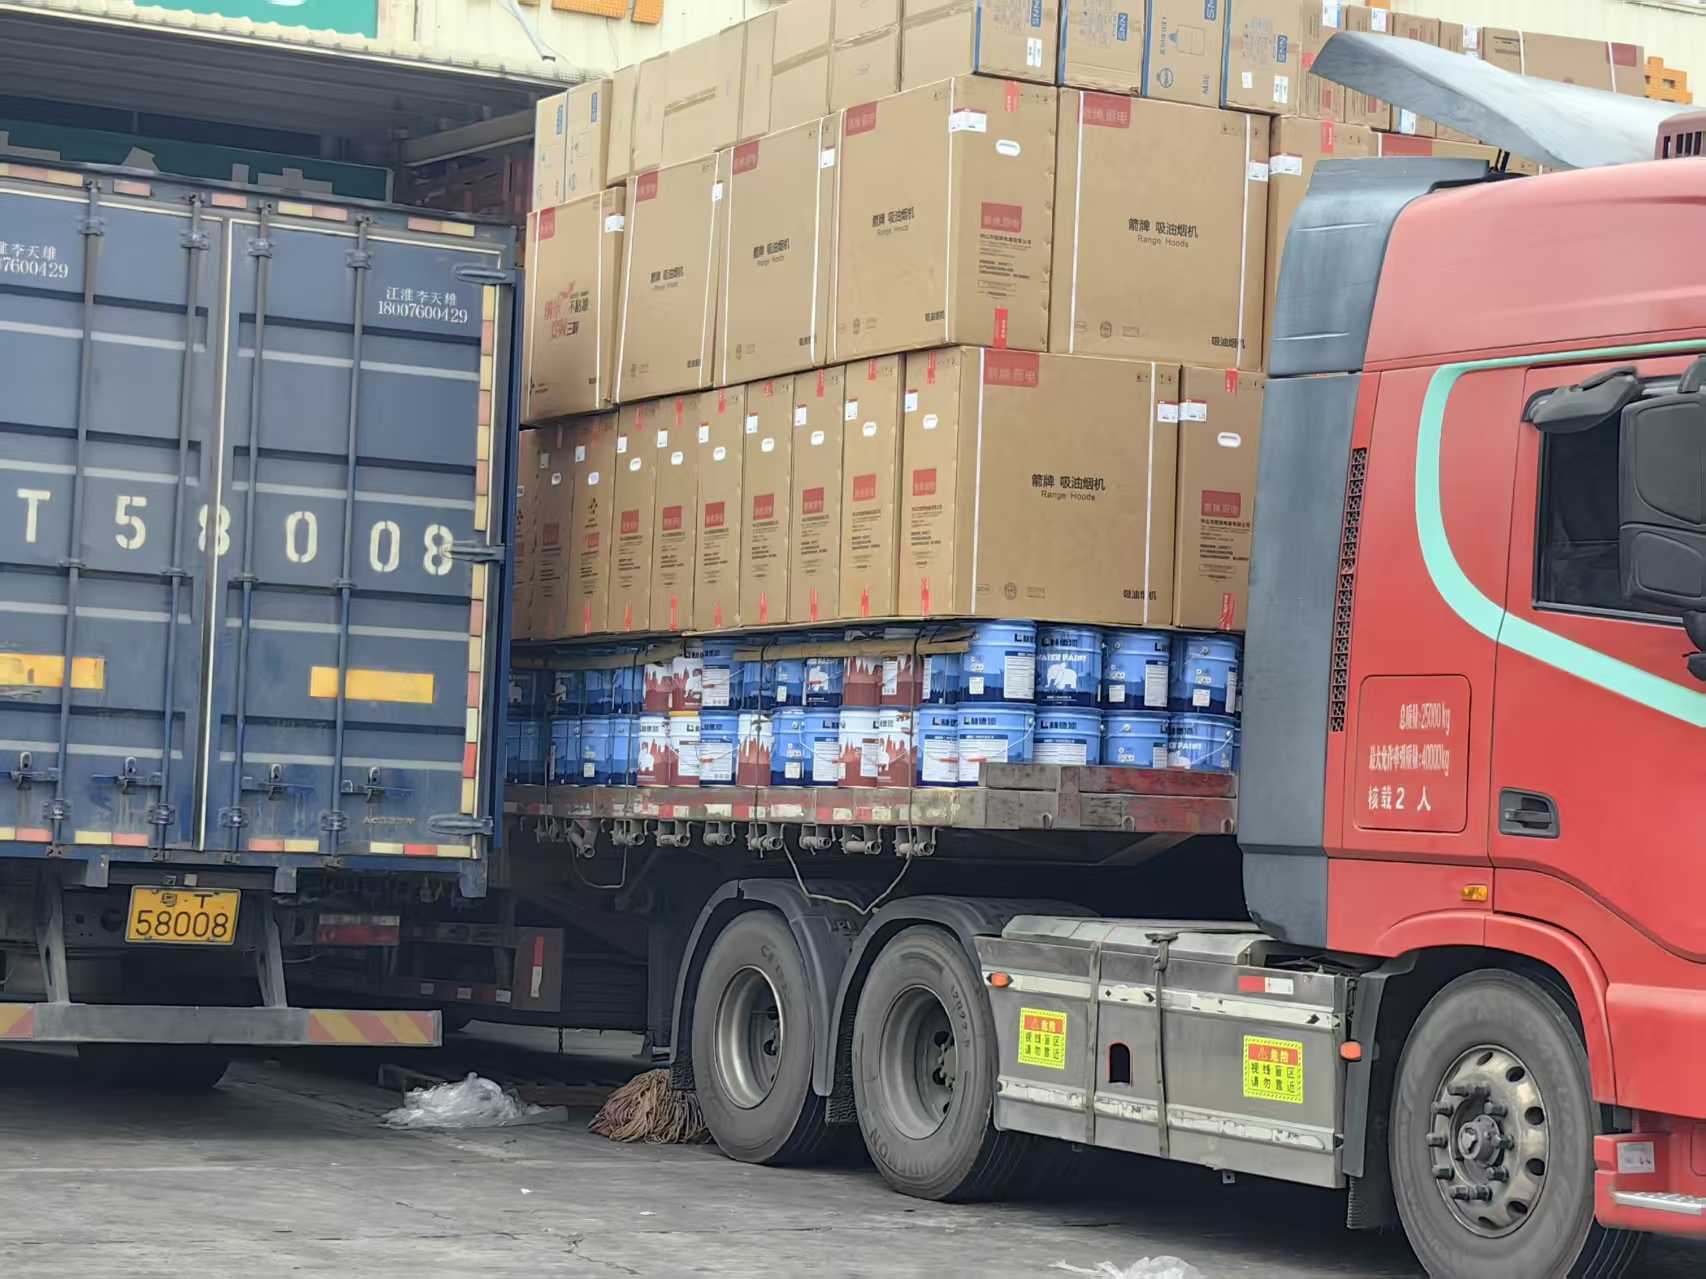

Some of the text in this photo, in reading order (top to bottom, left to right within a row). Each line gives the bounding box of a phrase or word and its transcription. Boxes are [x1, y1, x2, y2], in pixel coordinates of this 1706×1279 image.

[1155, 220, 1199, 239] 吸油烟机
[378, 301, 468, 323] 18007600429
[1031, 473, 1106, 491] 箭牌 吸油烟机
[1368, 784, 1433, 812] 核载 2 人
[135, 909, 229, 938] 58008
